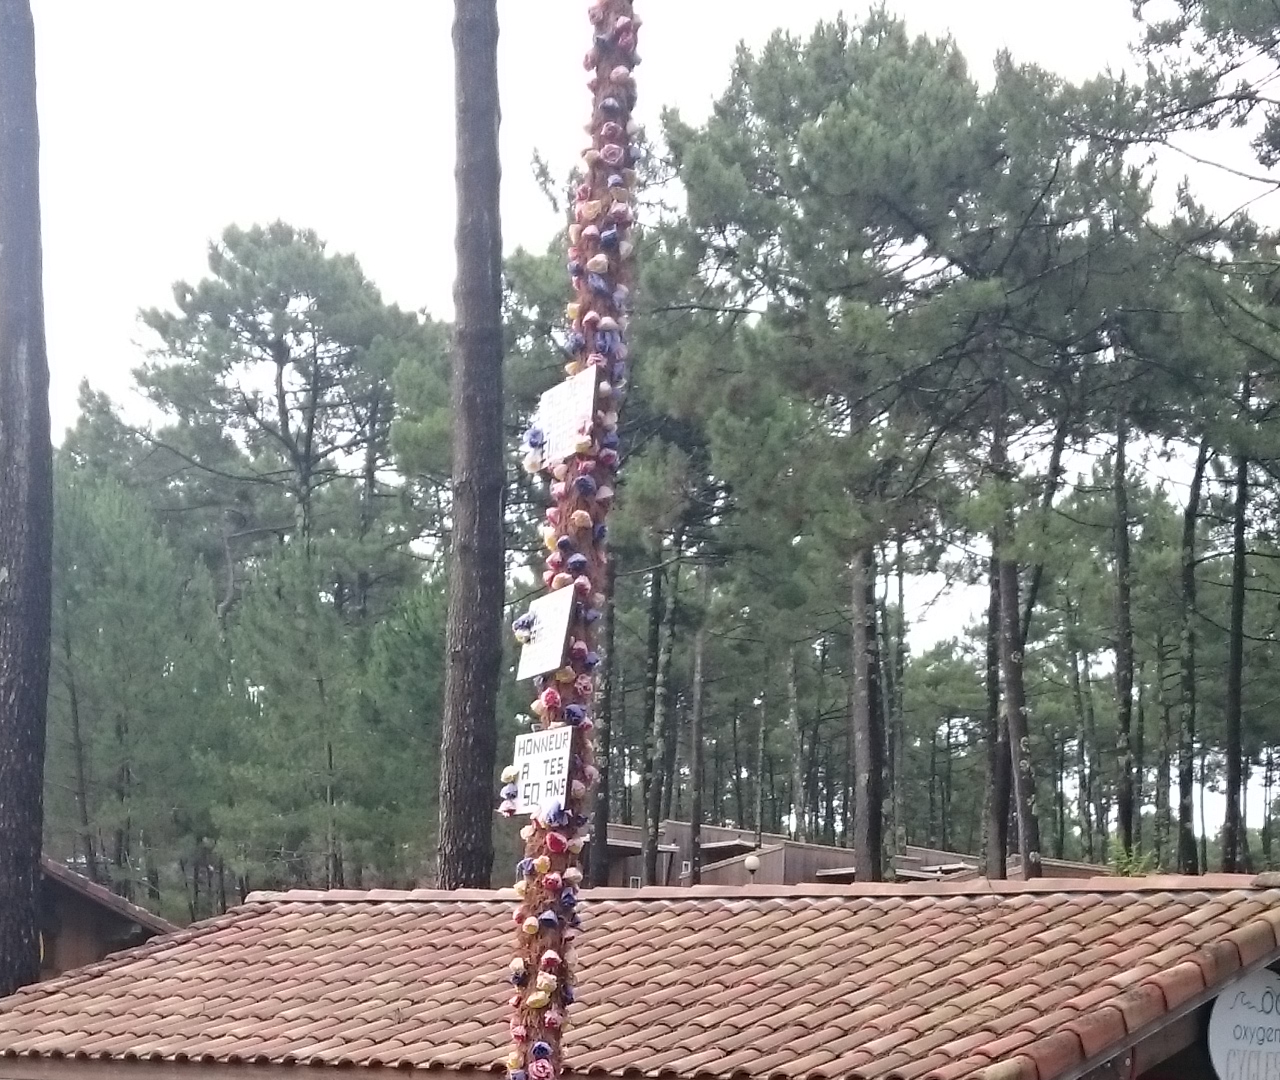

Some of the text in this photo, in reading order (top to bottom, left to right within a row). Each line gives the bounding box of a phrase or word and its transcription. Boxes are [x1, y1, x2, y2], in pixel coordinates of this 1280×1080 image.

[518, 732, 569, 756] HONNEUR
[543, 757, 564, 775] TES
[523, 778, 566, 807] 50 ANS
[1233, 1024, 1280, 1046] oxygen
